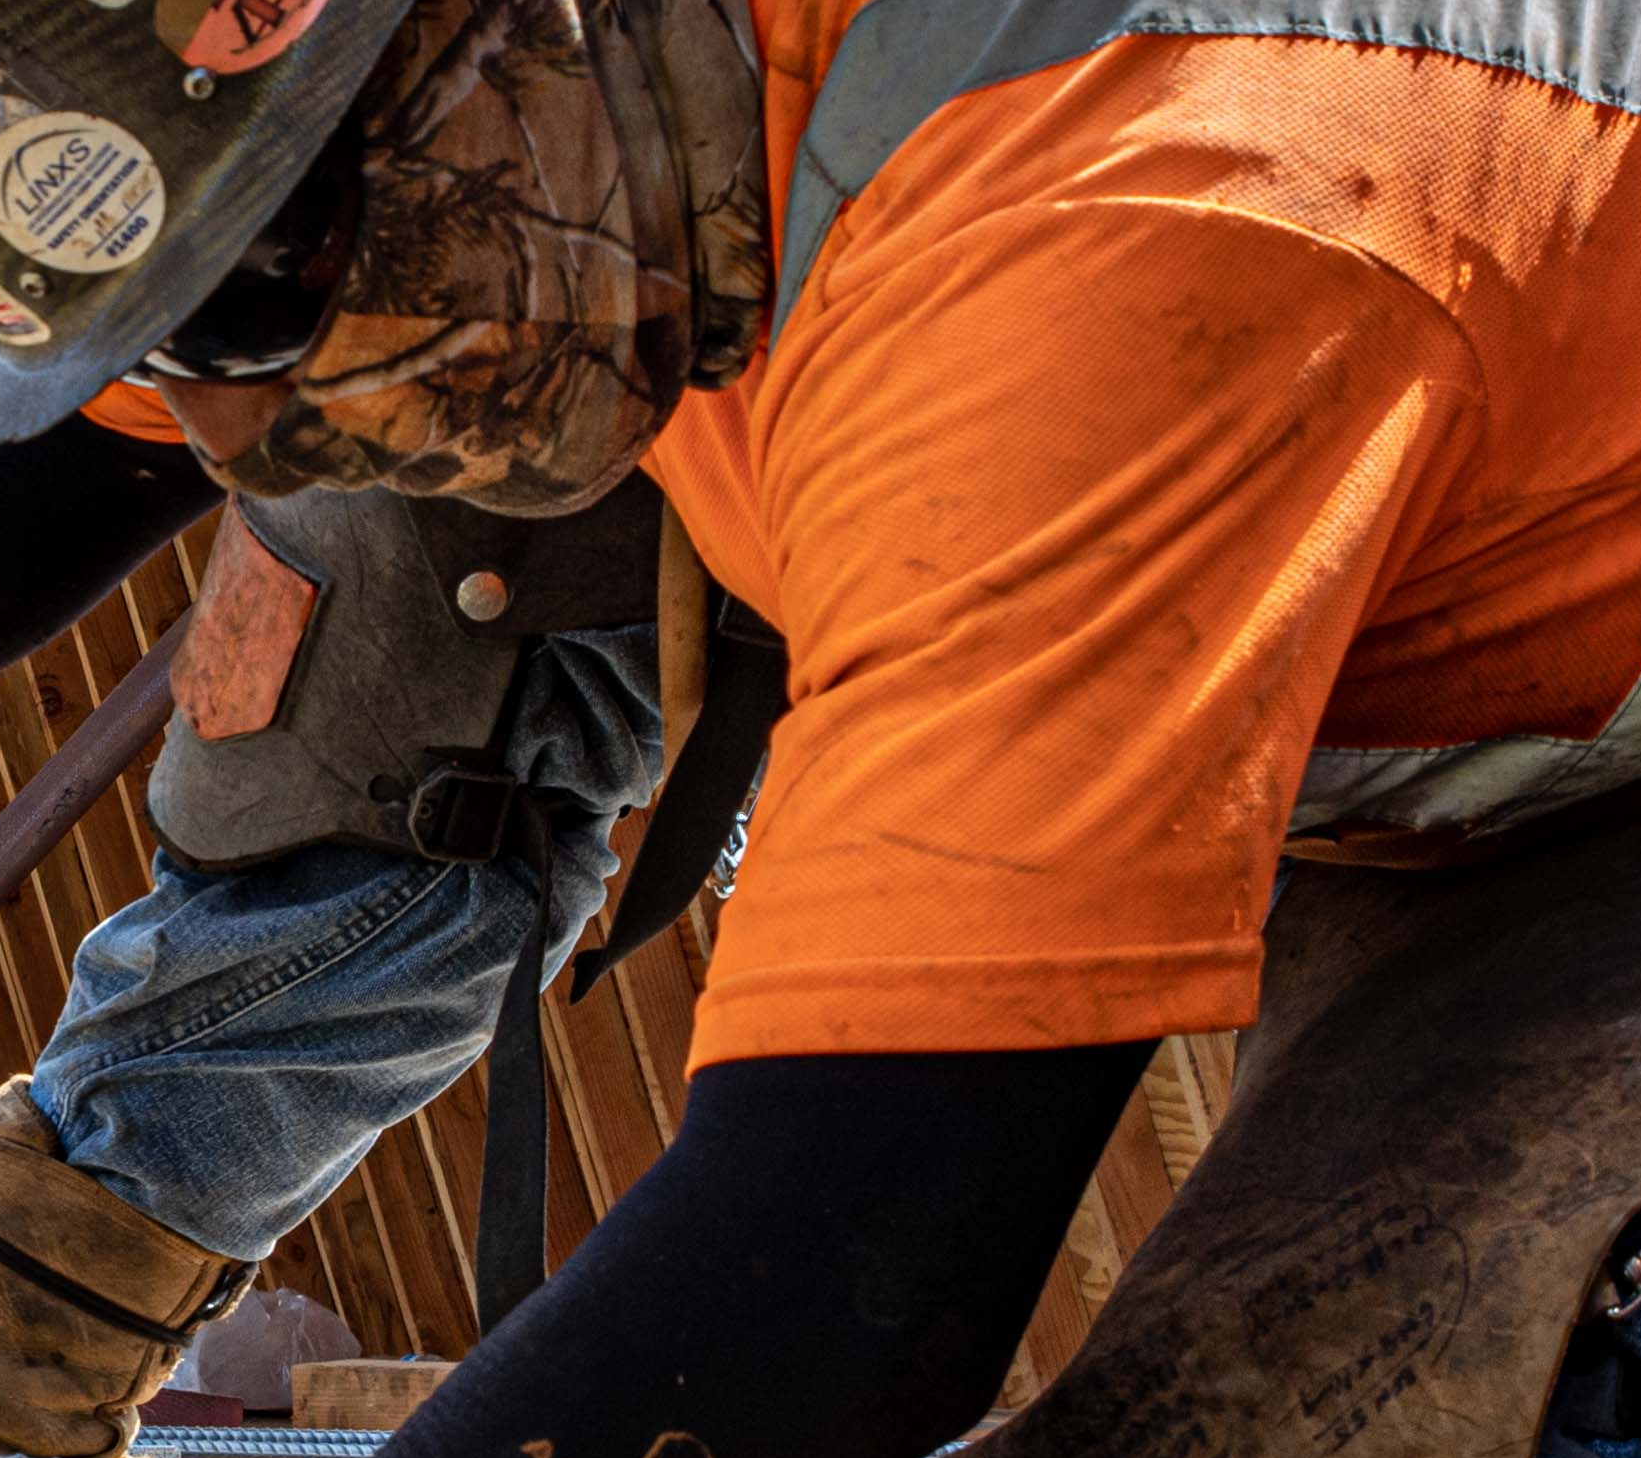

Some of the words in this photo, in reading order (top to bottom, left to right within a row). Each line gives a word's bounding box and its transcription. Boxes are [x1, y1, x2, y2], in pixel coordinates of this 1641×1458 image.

[15, 136, 91, 207] LINXS
[47, 216, 82, 250] SAFETY
[77, 157, 140, 222] ORIENTATION
